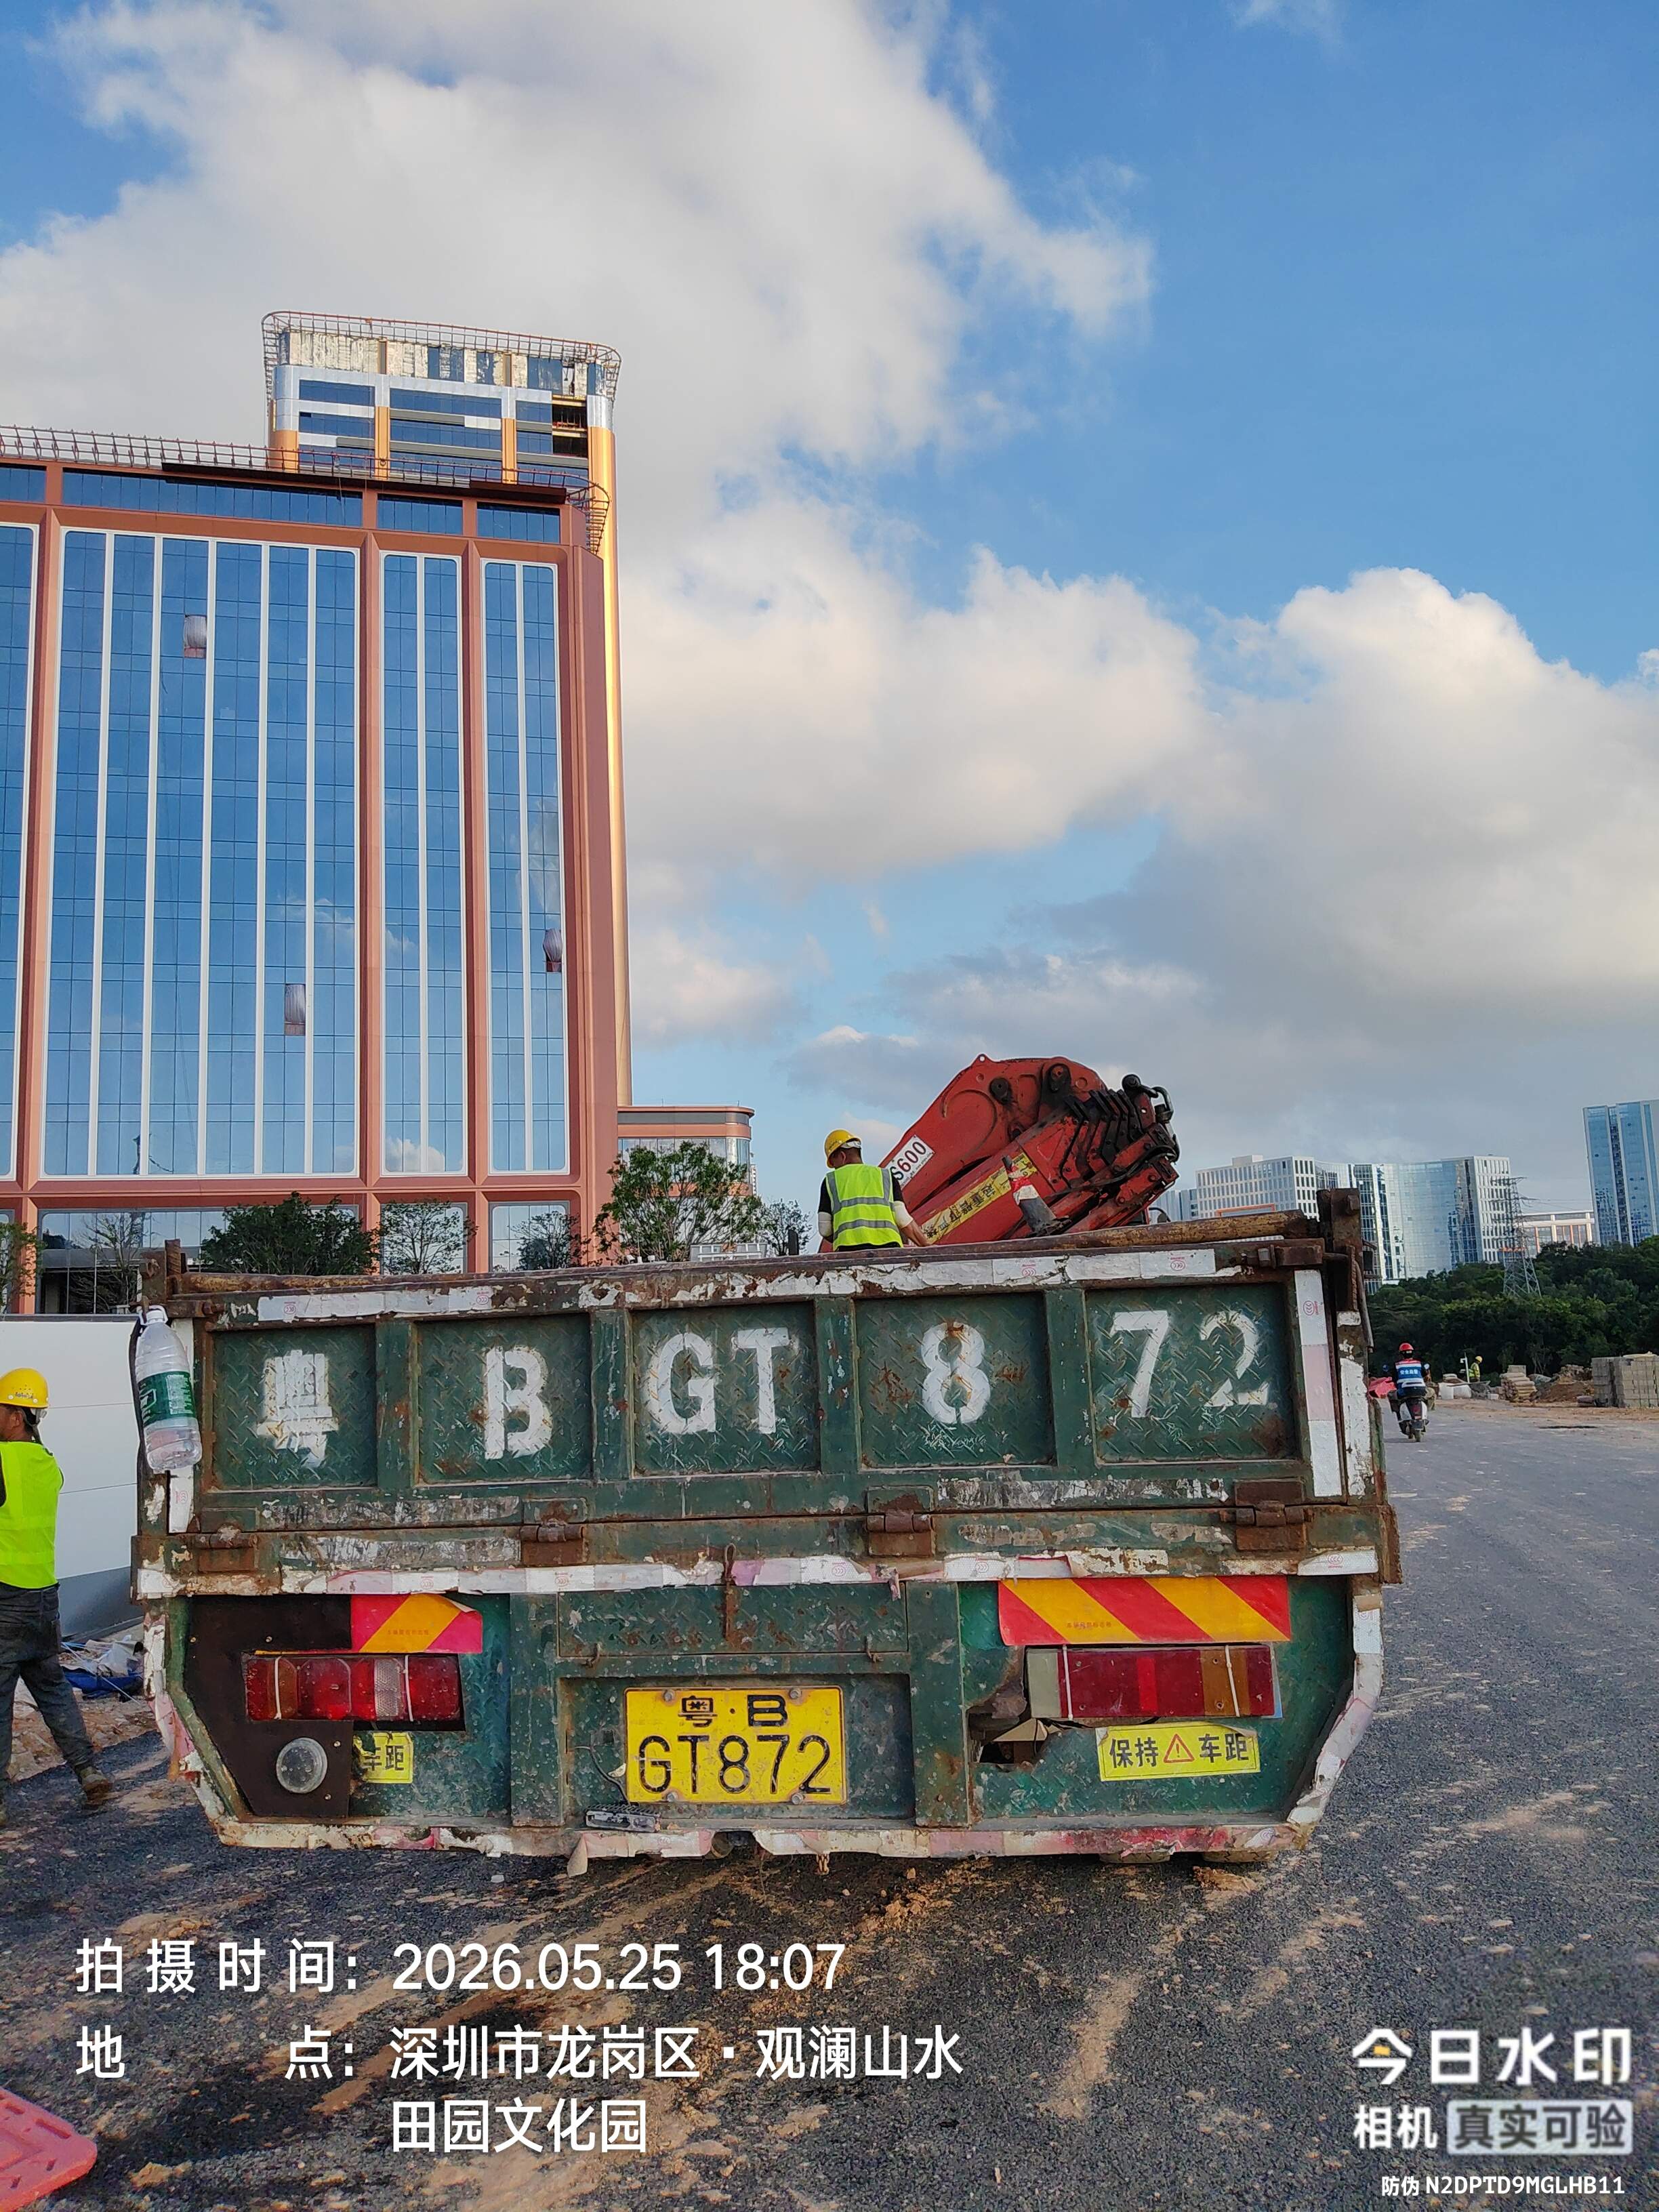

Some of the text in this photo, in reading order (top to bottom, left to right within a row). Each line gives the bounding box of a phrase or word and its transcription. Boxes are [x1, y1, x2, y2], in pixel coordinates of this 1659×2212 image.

[484, 1345, 552, 1459] B
[644, 1327, 797, 1434] GT
[921, 1321, 991, 1423] 8
[1109, 1310, 1270, 1418] 72
[639, 1734, 831, 1795] GT872
[1109, 1733, 1250, 1768] 保持 车距
